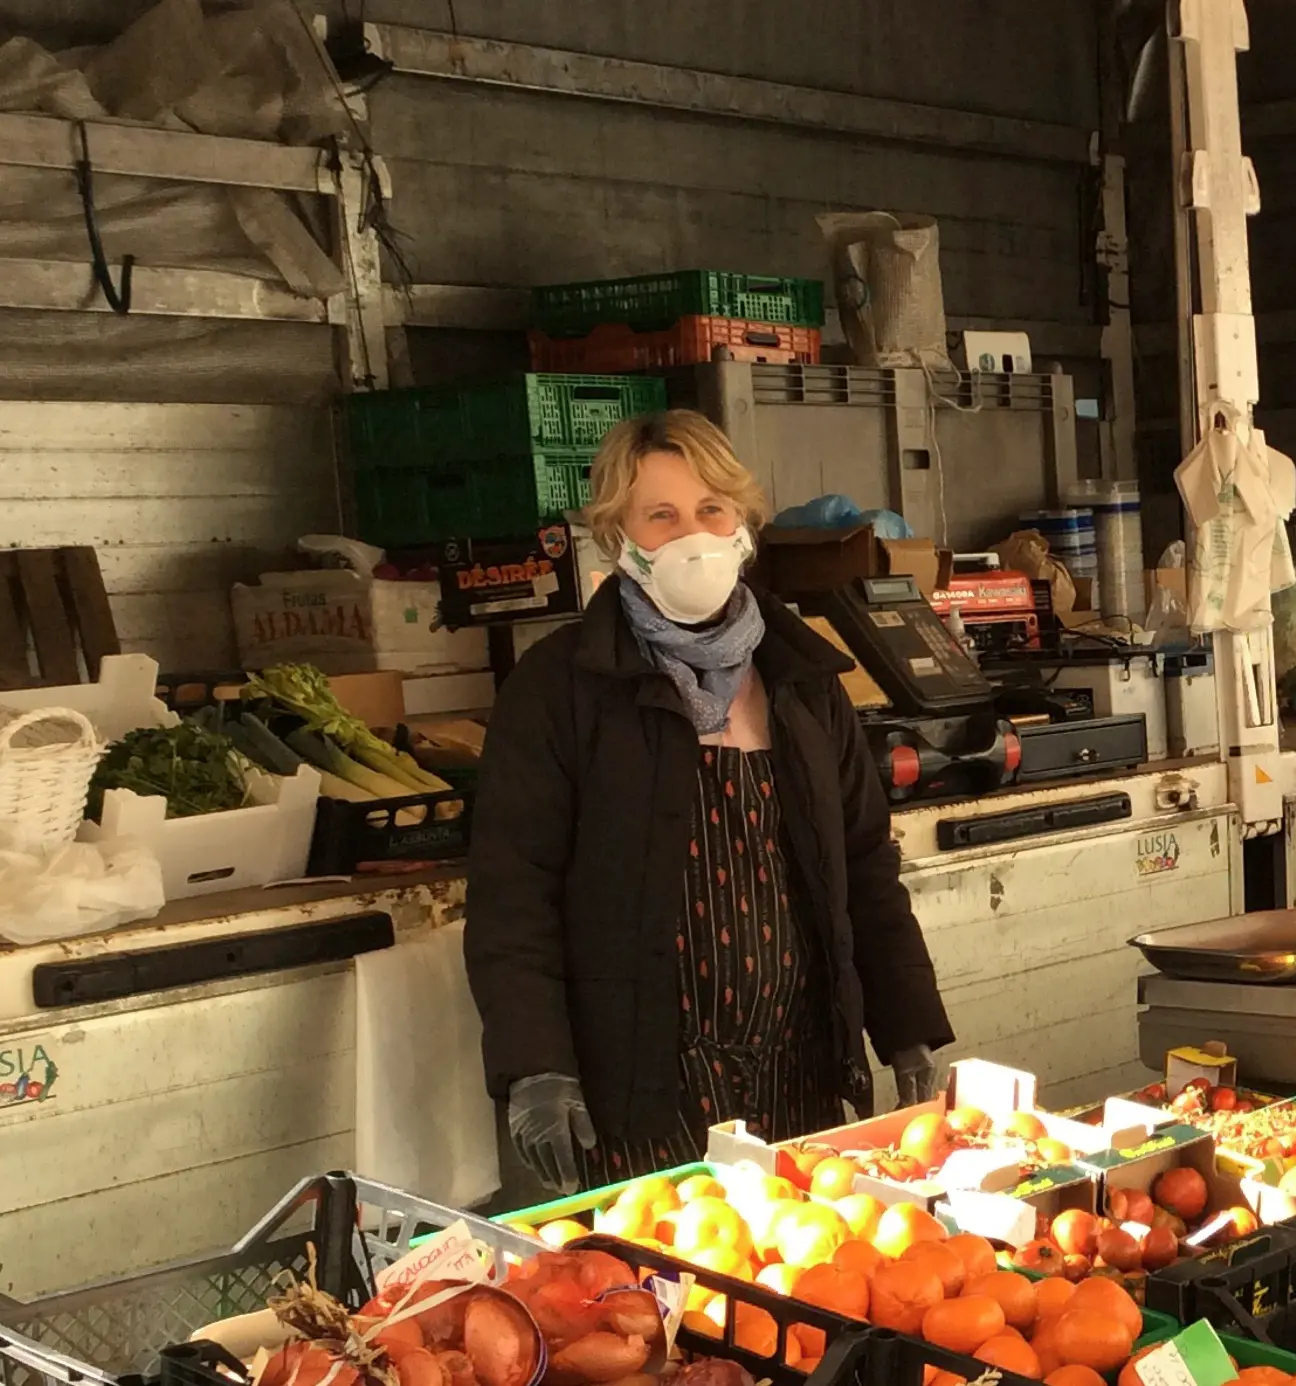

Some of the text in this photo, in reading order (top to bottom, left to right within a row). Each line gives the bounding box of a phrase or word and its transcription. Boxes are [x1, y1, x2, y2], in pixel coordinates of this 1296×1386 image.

[282, 592, 326, 607] Frutas
[252, 603, 373, 642] ALDAMA
[1136, 833, 1178, 856] LUSIA
